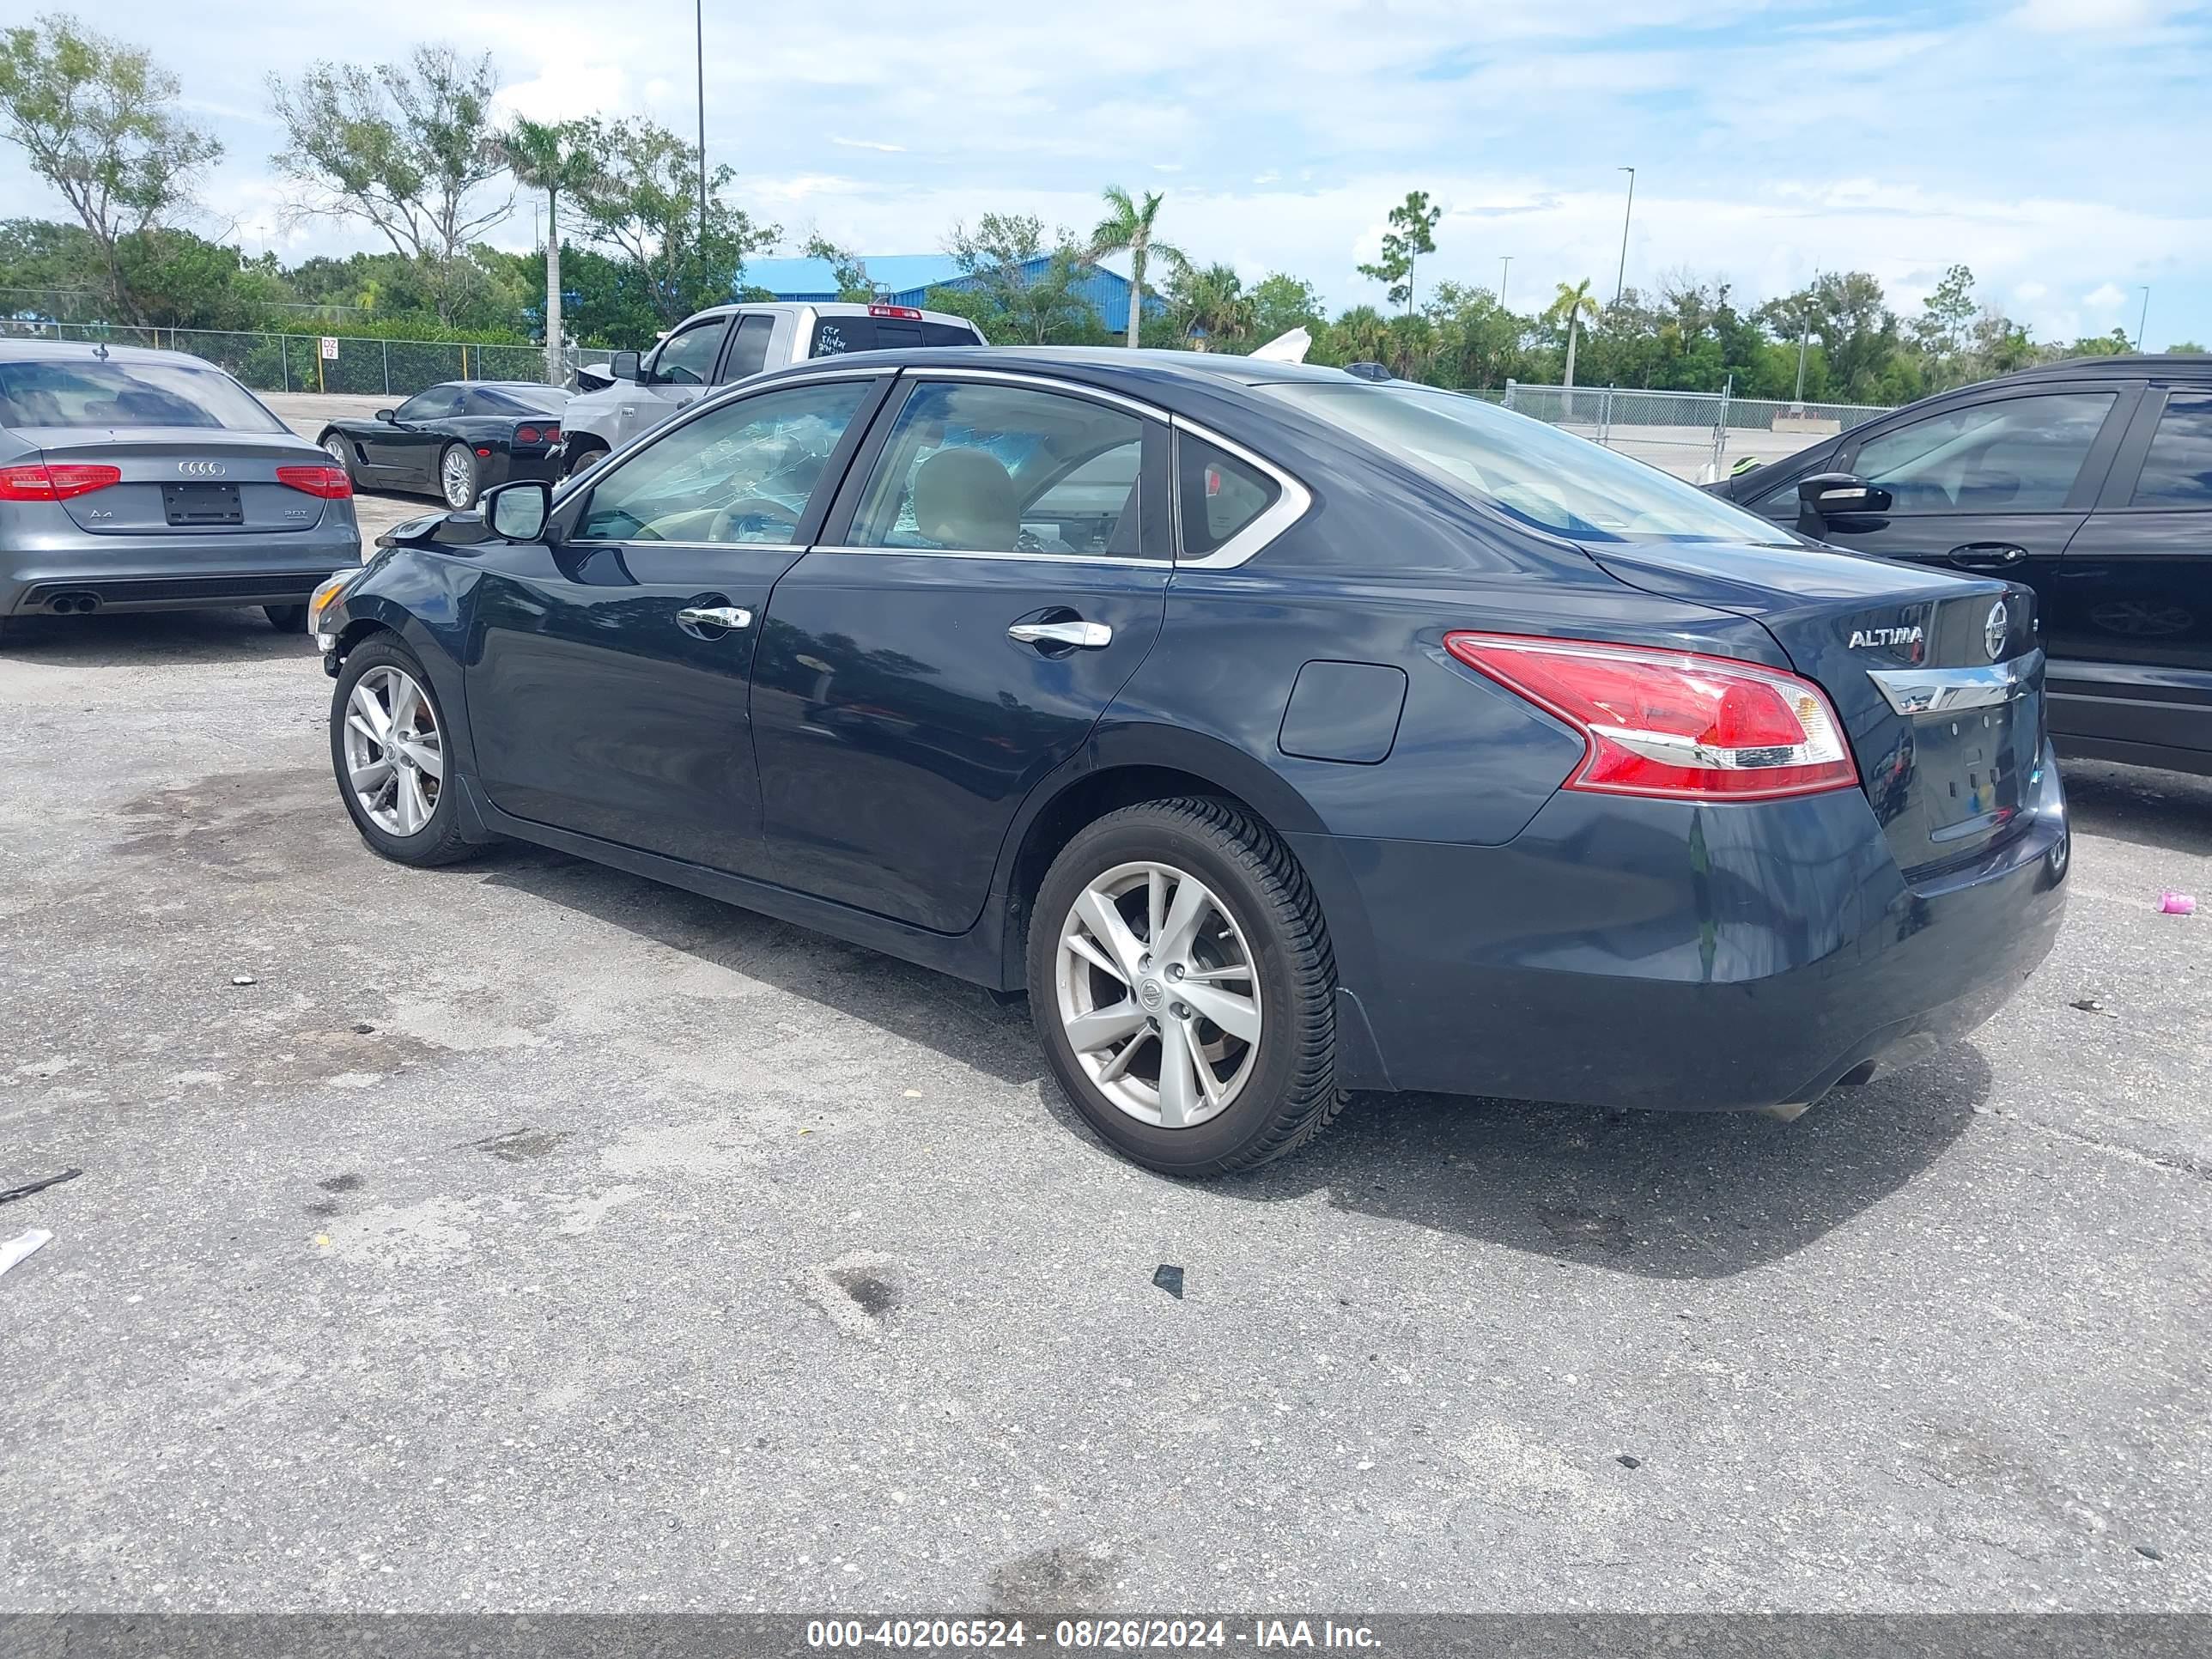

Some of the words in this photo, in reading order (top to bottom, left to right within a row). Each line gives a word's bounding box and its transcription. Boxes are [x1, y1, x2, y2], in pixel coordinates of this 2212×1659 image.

[324, 339, 337, 349] DZ
[326, 349, 334, 357] 12
[89, 509, 112, 519] A4
[1848, 625, 1924, 649] ALTIMA
